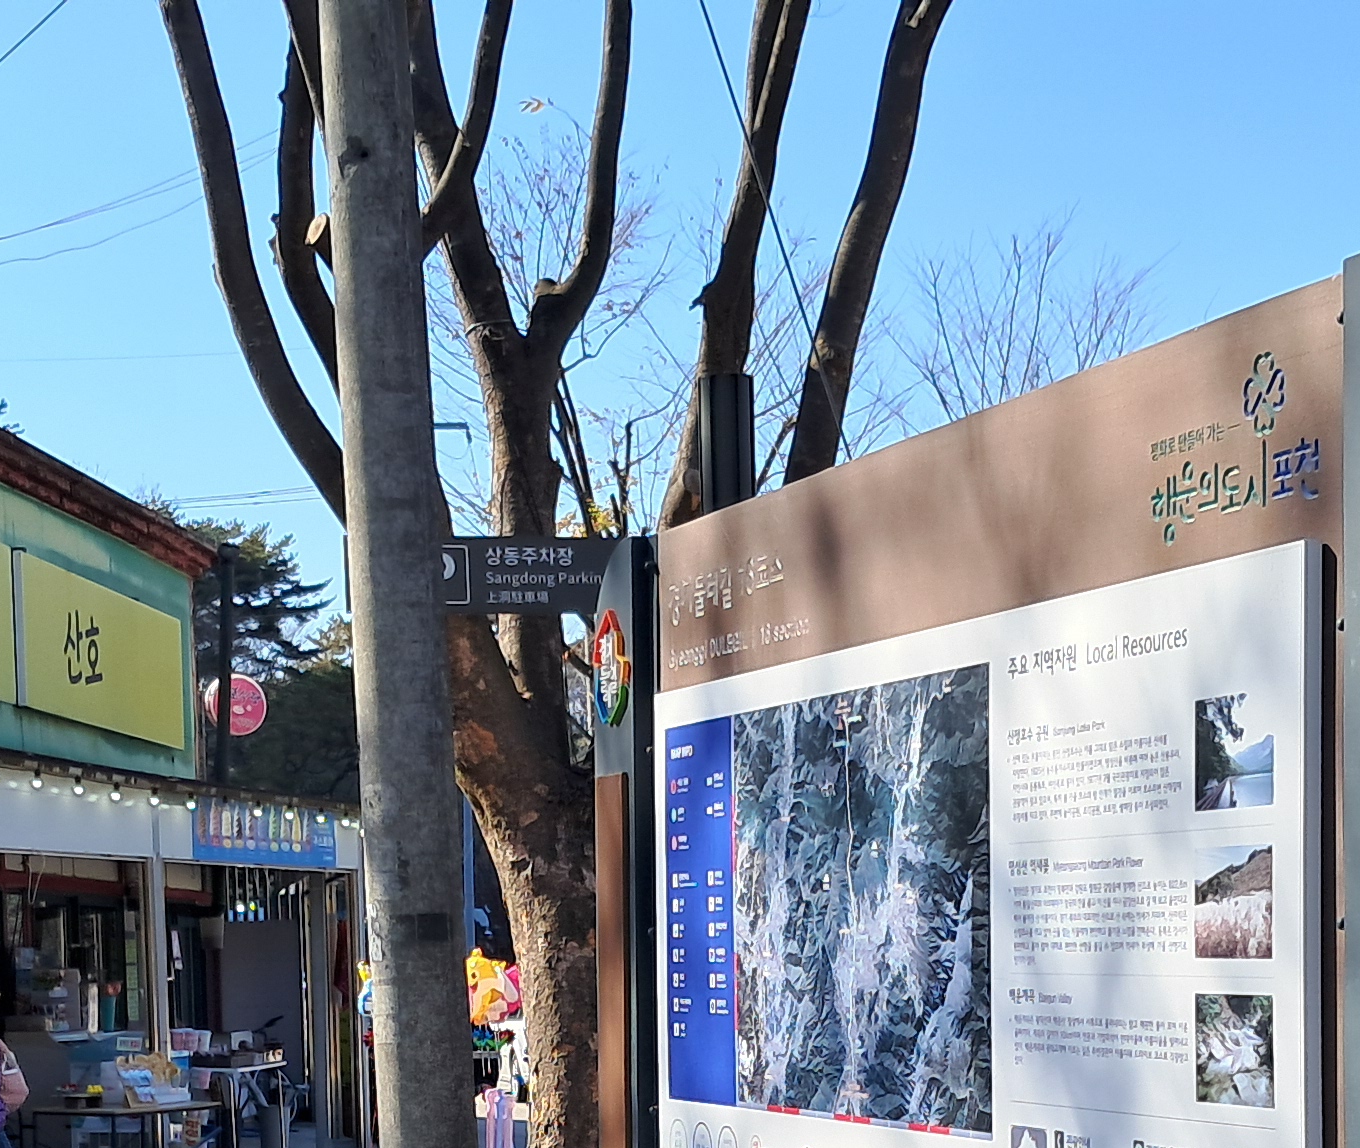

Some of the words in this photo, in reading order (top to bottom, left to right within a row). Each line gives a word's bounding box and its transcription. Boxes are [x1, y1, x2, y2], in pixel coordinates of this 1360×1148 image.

[1272, 437, 1320, 499] 포천
[485, 546, 574, 566] 상동주차장
[485, 571, 555, 588] Sangdong
[558, 571, 603, 585] Parkin
[62, 608, 104, 685] 산호
[1007, 656, 1029, 679] 주요
[1033, 644, 1077, 675] 지역자원
[1086, 635, 1118, 666] Local
[1122, 627, 1189, 659] Resources
